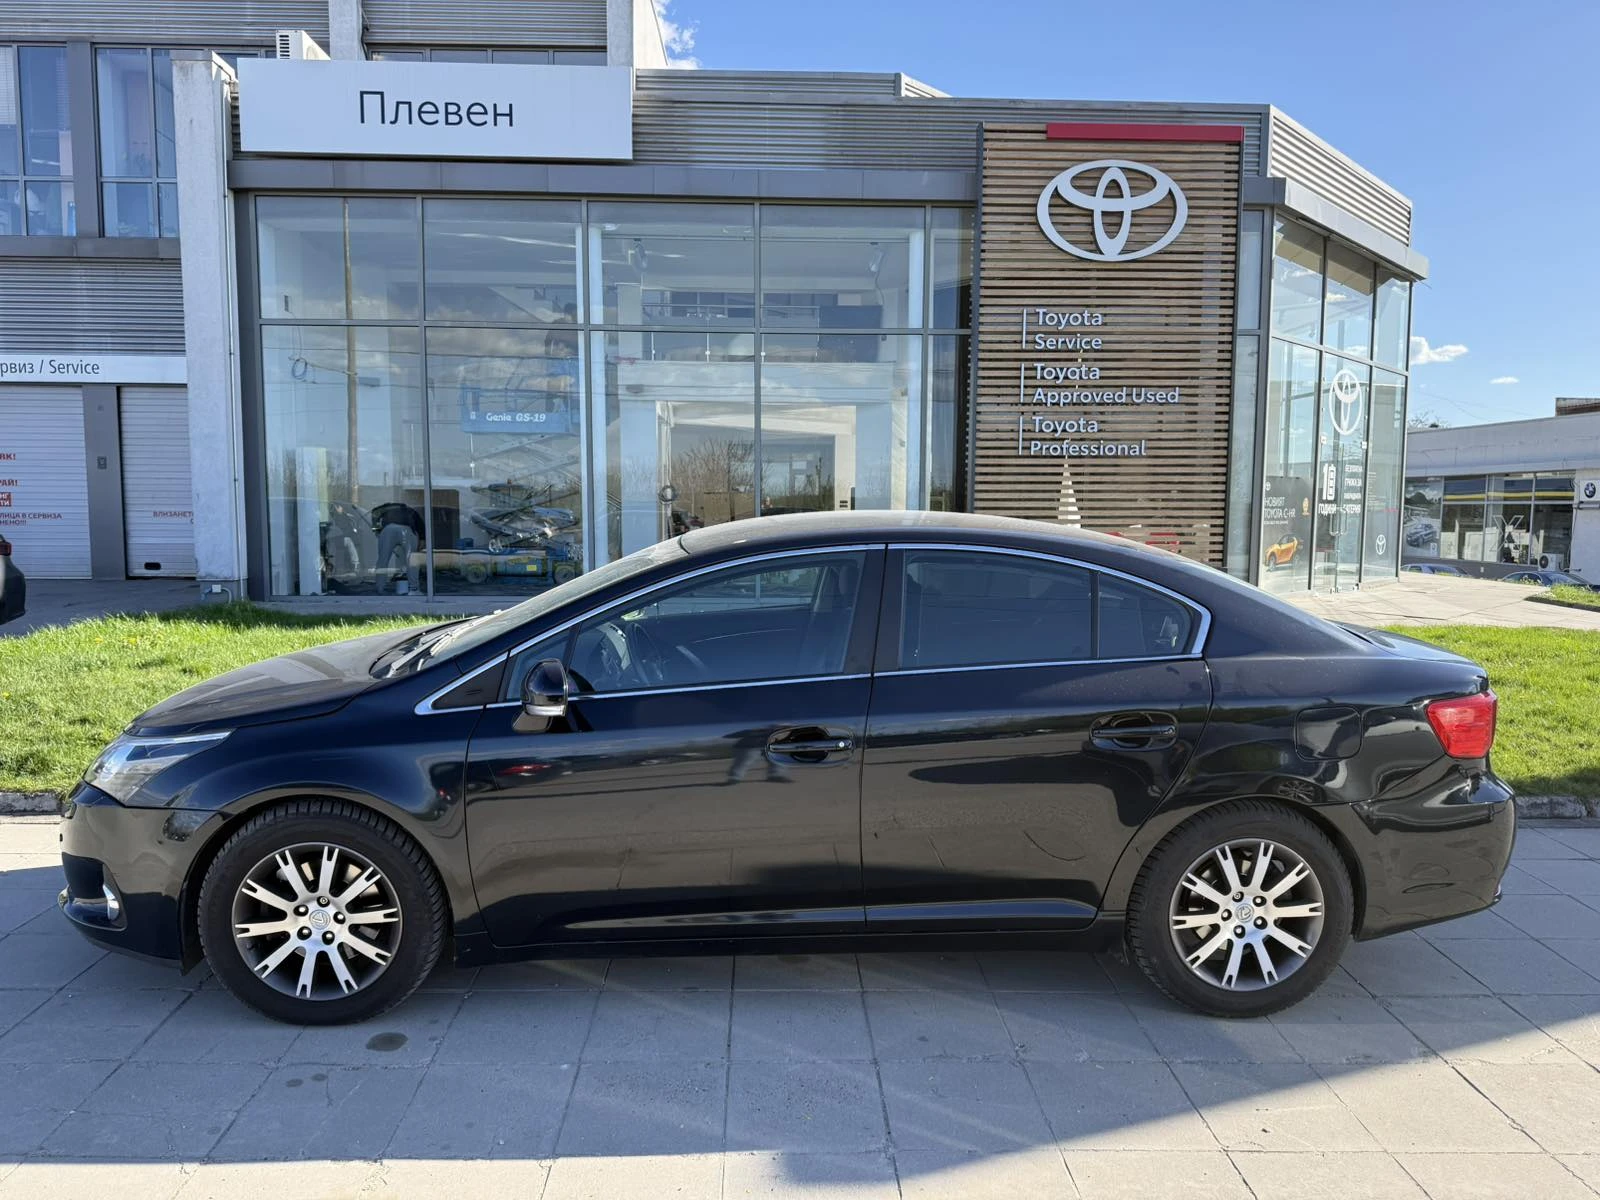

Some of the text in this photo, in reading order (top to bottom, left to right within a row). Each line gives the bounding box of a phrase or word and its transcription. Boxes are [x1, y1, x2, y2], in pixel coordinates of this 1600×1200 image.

[359, 90, 514, 127] Плевен
[1035, 308, 1103, 330] Toyota
[1034, 333, 1103, 350] Service
[49, 359, 100, 374] Service
[1033, 363, 1101, 384] Toyota
[1032, 387, 1180, 407] Approved Used
[486, 412, 546, 422] Genie GS-19
[1031, 416, 1099, 437] Toyota
[1030, 439, 1147, 456] Professional
